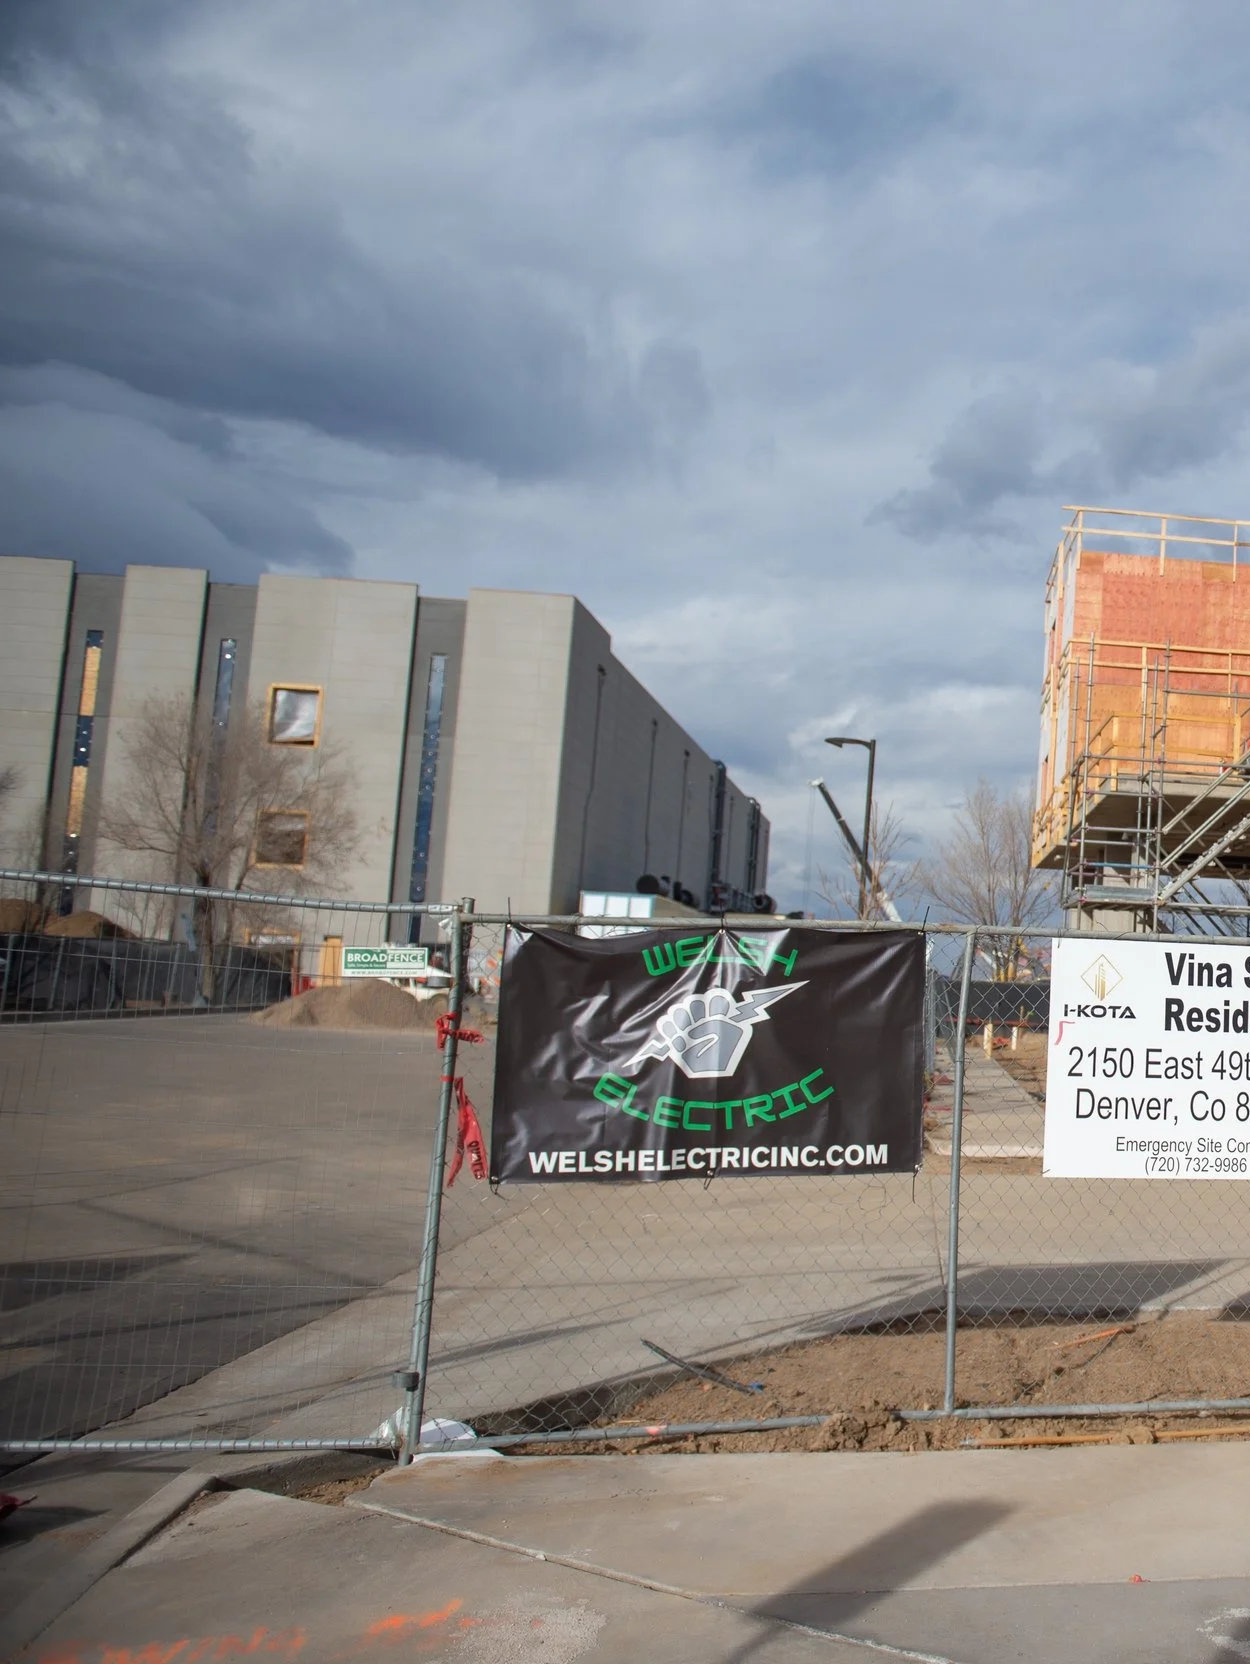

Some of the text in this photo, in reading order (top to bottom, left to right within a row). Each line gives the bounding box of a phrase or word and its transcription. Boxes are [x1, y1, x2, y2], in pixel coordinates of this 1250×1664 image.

[347, 953, 423, 962] BROADFENCE
[641, 936, 798, 977] WELSH
[1165, 952, 1233, 987] Vina
[1063, 1004, 1137, 1019] I-KOTA
[1067, 1046, 1134, 1078] 2150
[1145, 1048, 1203, 1080] East
[593, 1067, 835, 1131] ELECTRIC
[1076, 1088, 1178, 1125] Denver,
[1190, 1090, 1226, 1121] Co
[528, 1144, 889, 1174] WELSHELECTRICINC.COM
[1116, 1136, 1192, 1156] Emergency
[1196, 1137, 1222, 1153] Site
[1144, 1156, 1248, 1176] (720) 732-9986
